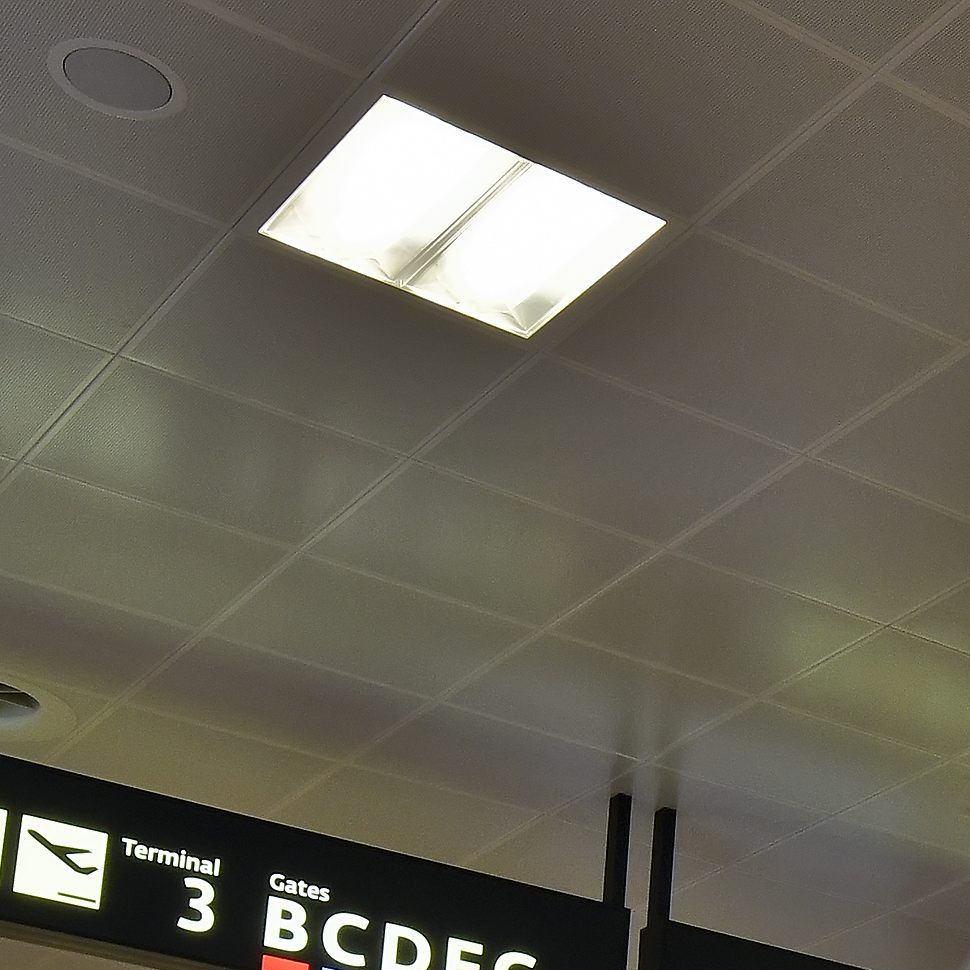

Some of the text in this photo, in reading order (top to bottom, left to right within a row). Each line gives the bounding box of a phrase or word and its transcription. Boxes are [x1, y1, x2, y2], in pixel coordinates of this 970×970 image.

[122, 837, 221, 877] Terminal
[176, 876, 217, 933] 3
[269, 873, 331, 903] Gates
